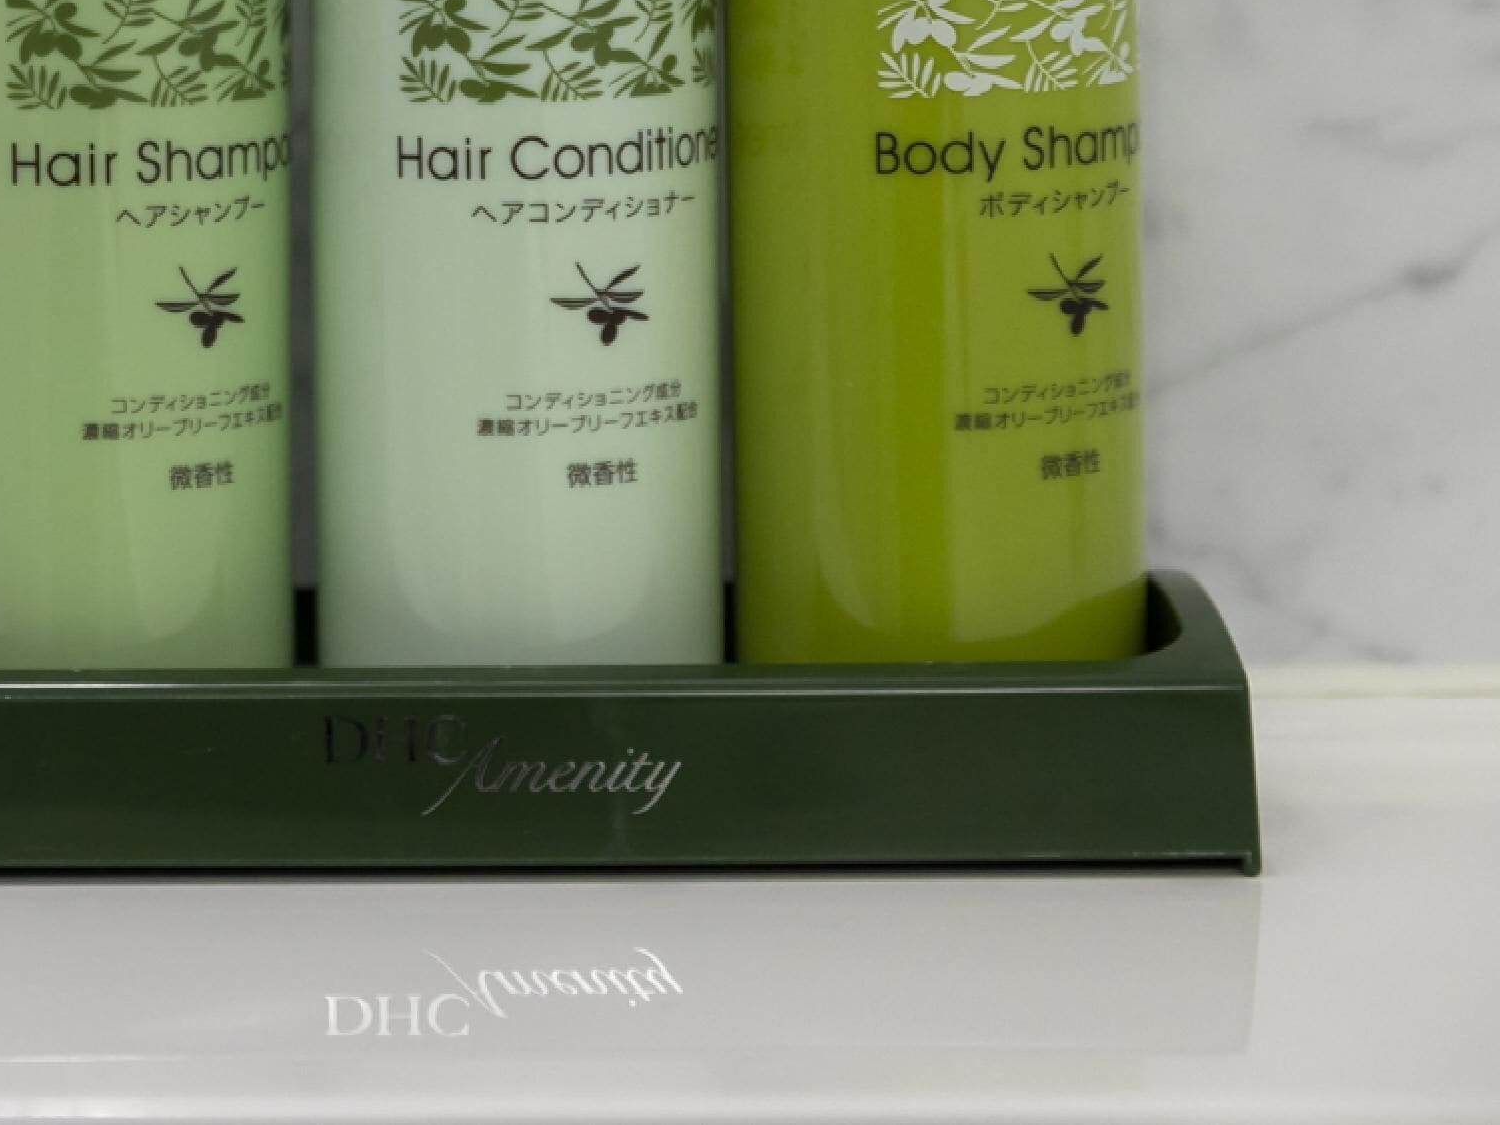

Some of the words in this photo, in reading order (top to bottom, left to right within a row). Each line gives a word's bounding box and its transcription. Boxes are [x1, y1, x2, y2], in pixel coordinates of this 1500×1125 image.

[10, 141, 118, 187] Hair
[396, 135, 493, 181] Hair
[875, 130, 1006, 183] Body
[115, 194, 266, 229] ヘアシャンプー
[471, 190, 696, 226] ヘアコンディショナー
[979, 178, 1131, 219] ボディシャンプー
[505, 379, 682, 412] コンディショニング成分
[169, 460, 235, 491] 微香性
[566, 457, 639, 489] 微香性
[1040, 448, 1100, 481] 微香性
[324, 714, 467, 765] DHC
[420, 736, 683, 816] Amenity
